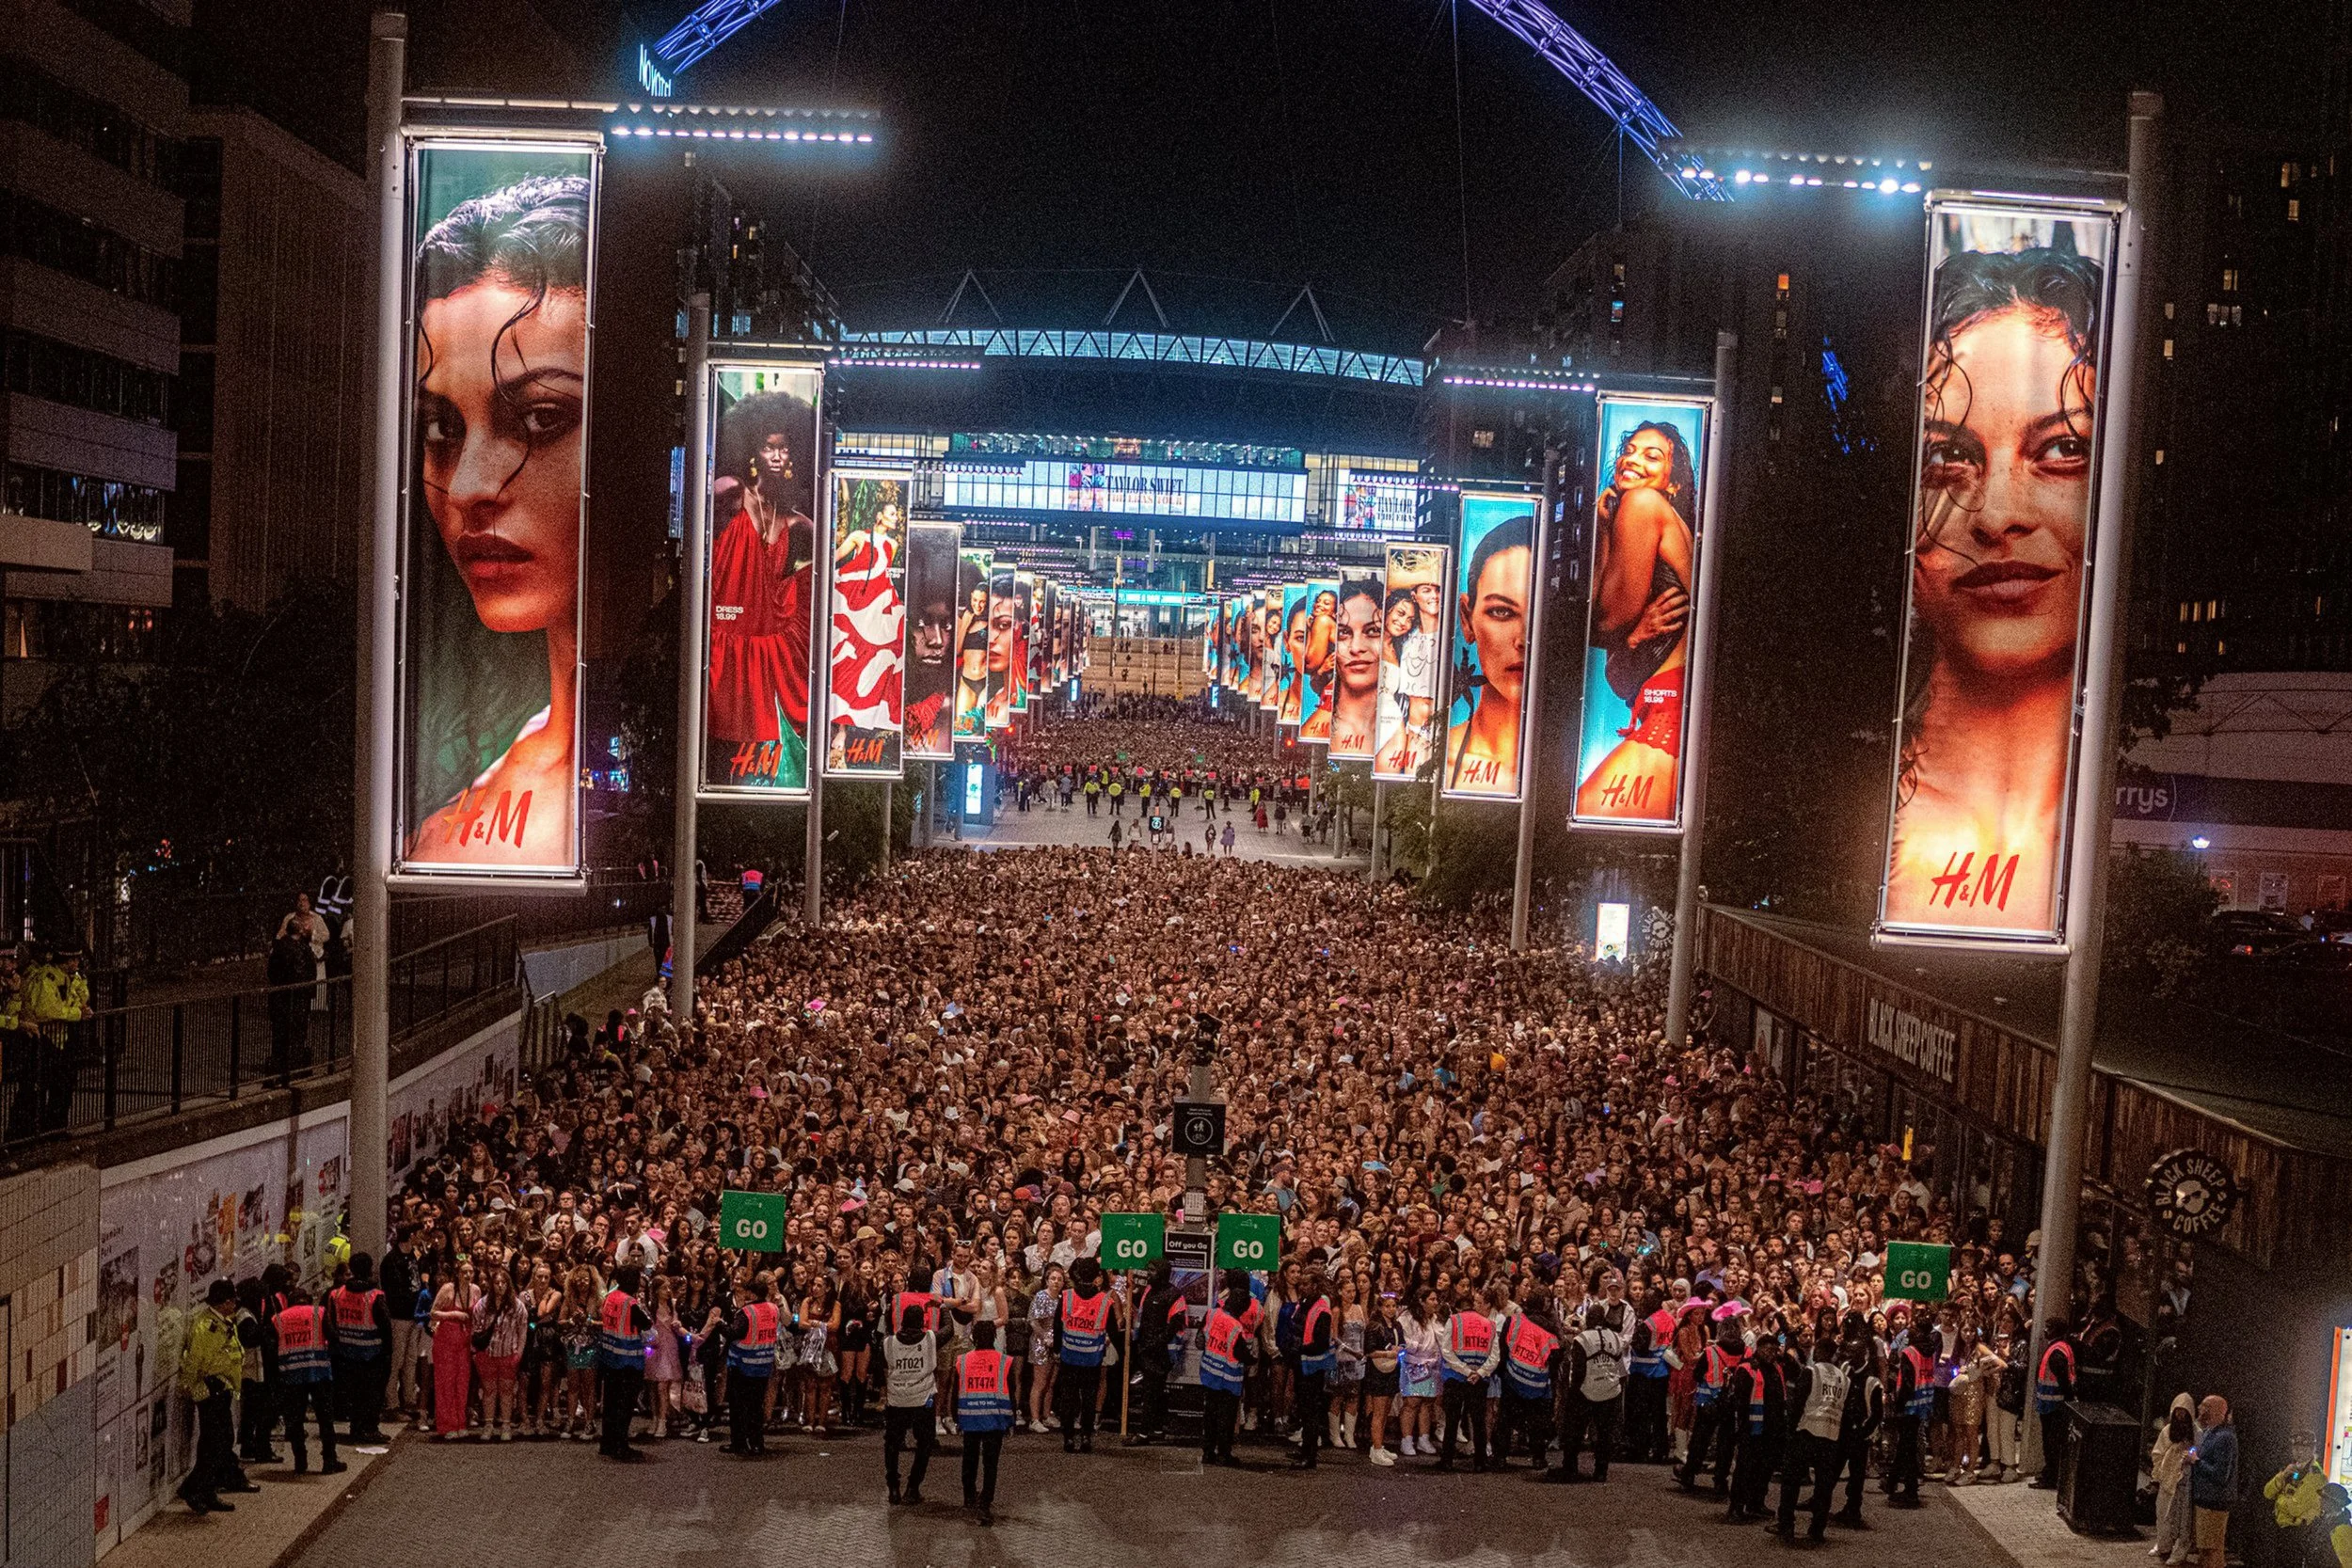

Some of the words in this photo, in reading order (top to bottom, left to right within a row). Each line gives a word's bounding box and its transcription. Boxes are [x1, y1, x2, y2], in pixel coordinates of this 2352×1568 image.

[1105, 475, 1150, 495] TAYLOR
[1150, 478, 1184, 497] SWIFT
[1377, 496, 1413, 515] TAYLOR
[716, 605, 744, 613] DRESS
[730, 741, 784, 779] H&M
[1388, 750, 1418, 769] H&M
[1463, 760, 1502, 785] H&M
[1601, 774, 1655, 810] H&M
[2115, 786, 2169, 815] rrys
[443, 787, 533, 849] H&M
[1929, 850, 2021, 912] H&M
[1867, 997, 1896, 1053] BLACK
[1894, 1008, 1921, 1066] SHEEP
[1919, 1022, 1956, 1084] COFFEE
[2154, 1162, 2185, 1207] BLACK
[2186, 1158, 2227, 1187] SHEEP
[736, 1218, 768, 1240] GO
[2172, 1202, 2228, 1234] COFFEE
[1116, 1239, 1148, 1259] GO
[1168, 1240, 1183, 1249] Off
[1197, 1242, 1208, 1250] Go
[1232, 1239, 1264, 1259] GO
[1900, 1270, 1932, 1290] GO
[896, 1355, 925, 1370] RT021
[967, 1376, 995, 1389] RT474
